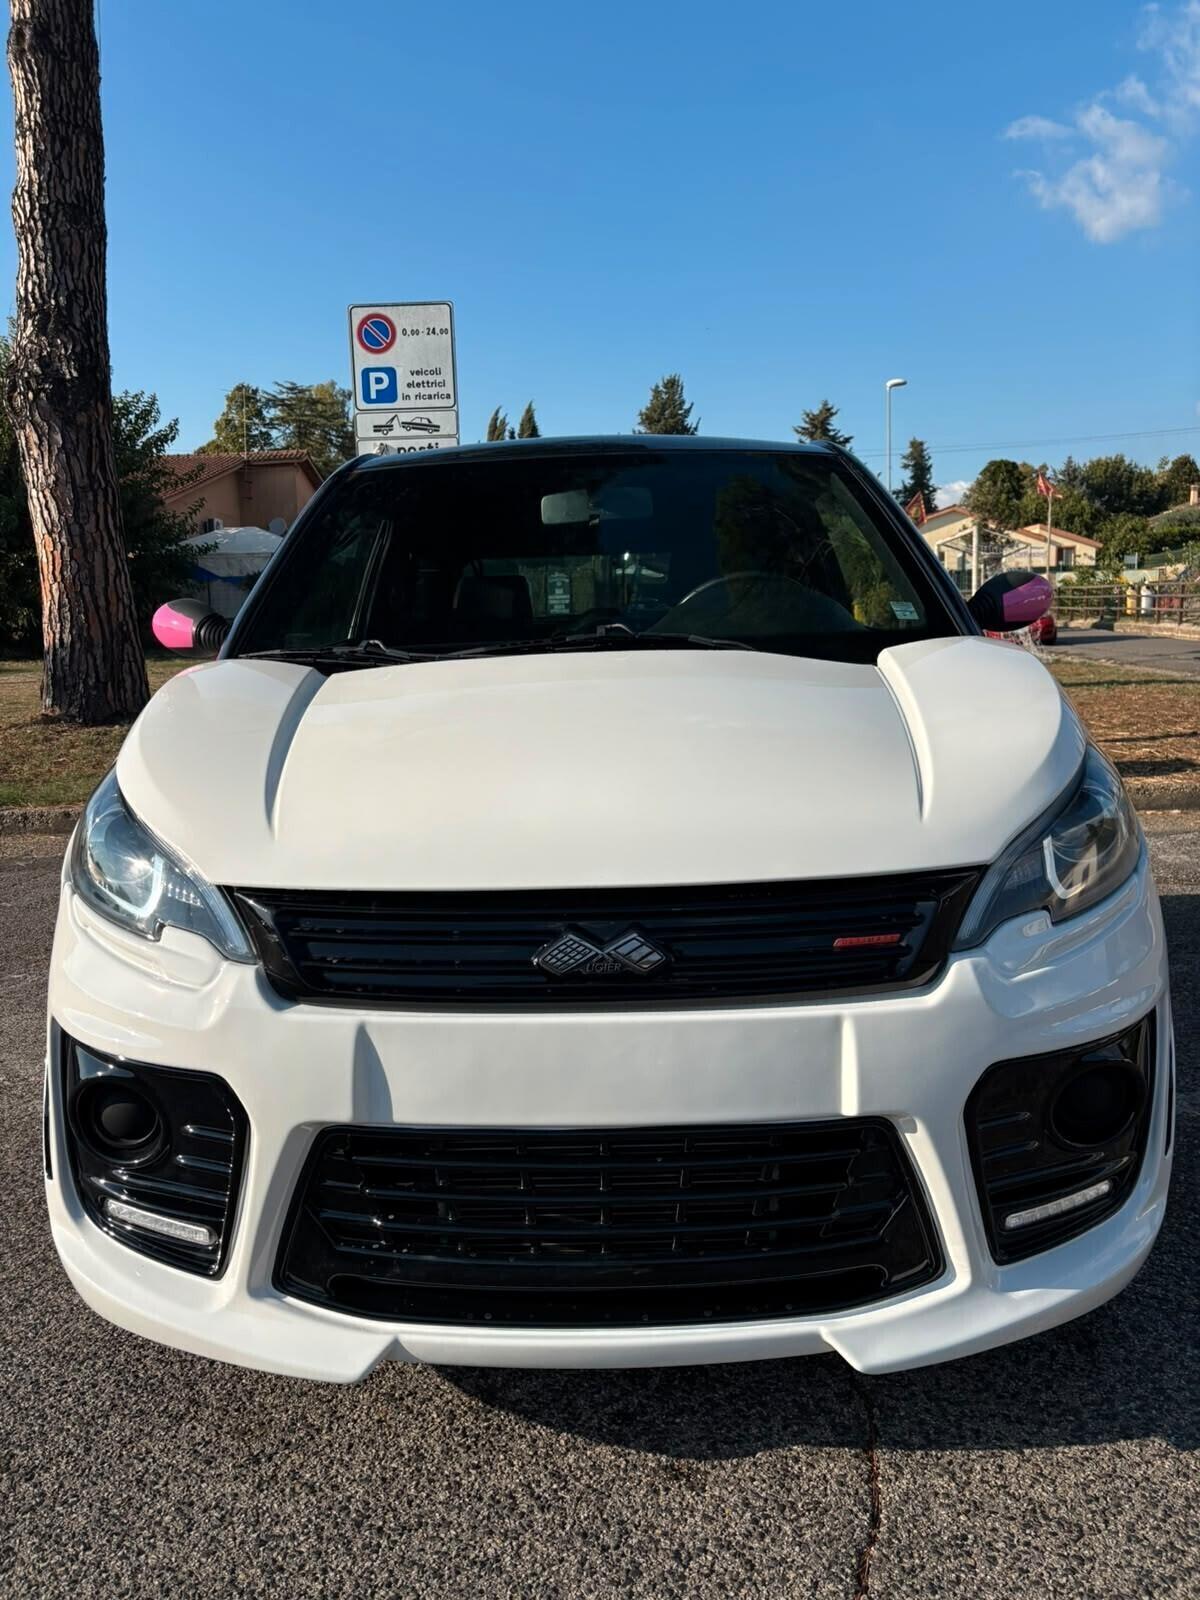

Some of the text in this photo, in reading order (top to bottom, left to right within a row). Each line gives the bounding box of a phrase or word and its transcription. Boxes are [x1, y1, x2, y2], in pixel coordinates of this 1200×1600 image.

[410, 367, 442, 376] veicoli
[369, 372, 390, 400] P
[406, 379, 446, 388] elettrici
[402, 392, 451, 400] in ricarica
